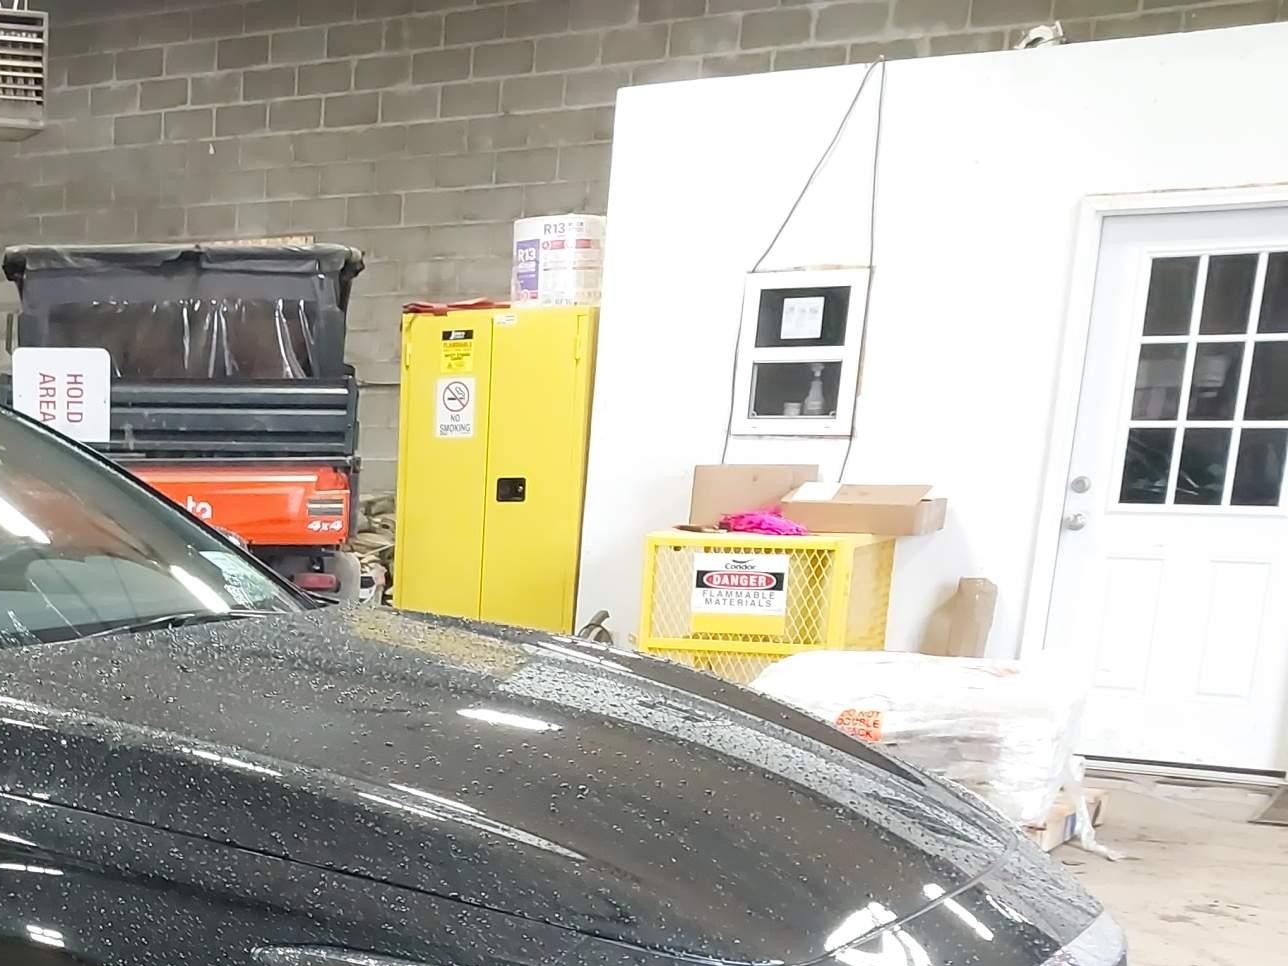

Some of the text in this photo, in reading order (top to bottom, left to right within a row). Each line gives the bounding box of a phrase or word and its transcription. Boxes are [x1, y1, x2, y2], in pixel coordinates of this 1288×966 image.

[544, 223, 565, 234] R13
[518, 248, 536, 262] R13
[39, 372, 56, 422] AREA
[67, 374, 83, 423] HOLD
[450, 414, 461, 423] NO
[439, 423, 471, 433] SMOKING
[307, 520, 343, 532] 4x4
[713, 575, 767, 587] DANGER
[703, 590, 775, 600] FLAMMABLE
[705, 598, 772, 607] MATERIALS
